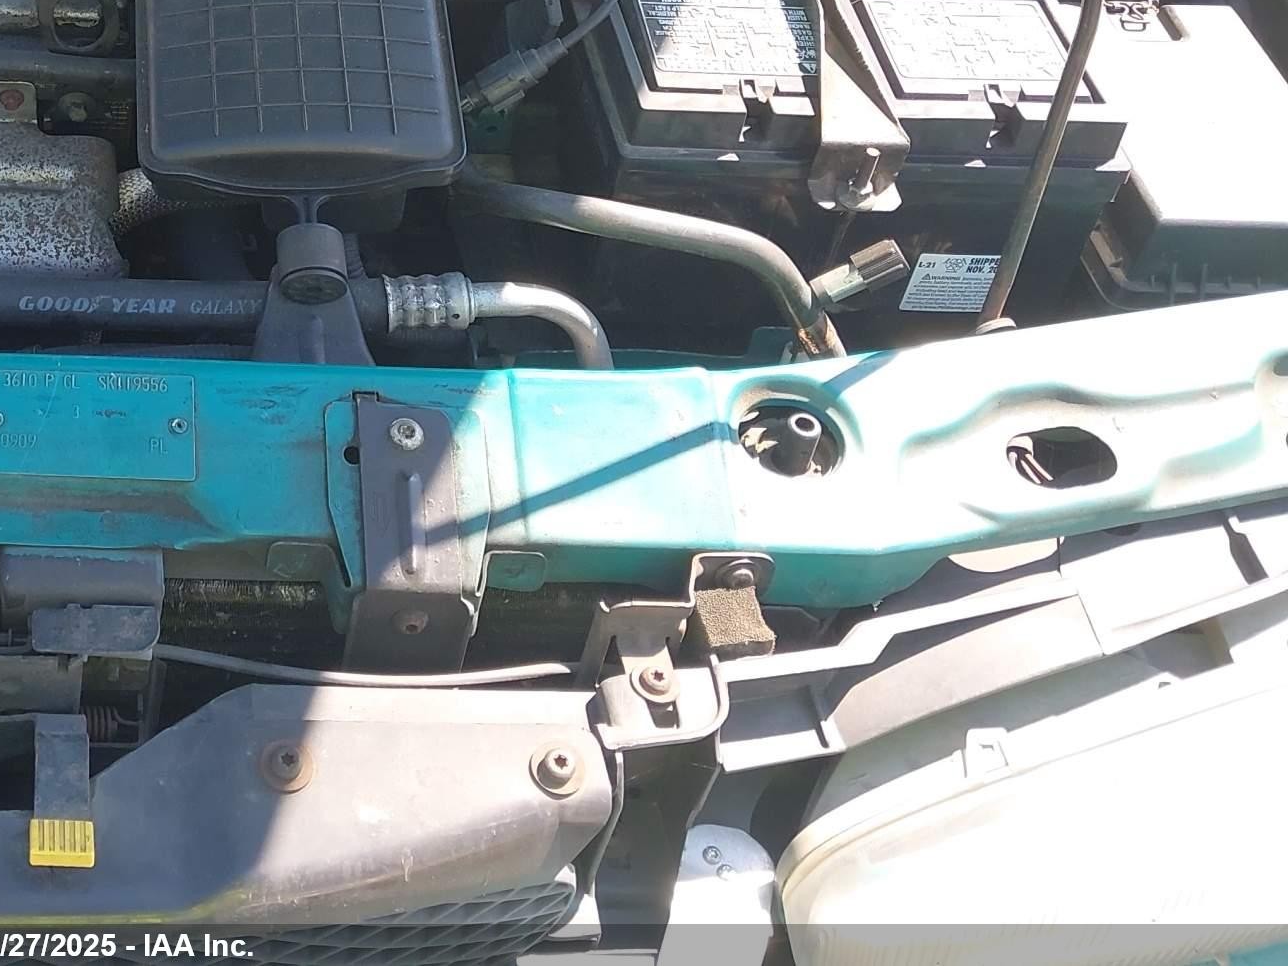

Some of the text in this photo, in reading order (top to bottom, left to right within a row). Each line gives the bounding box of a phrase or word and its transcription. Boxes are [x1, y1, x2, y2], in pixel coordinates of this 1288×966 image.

[190, 298, 263, 315] GALAXY
[4, 372, 38, 387] 3610
[45, 374, 55, 387] P
